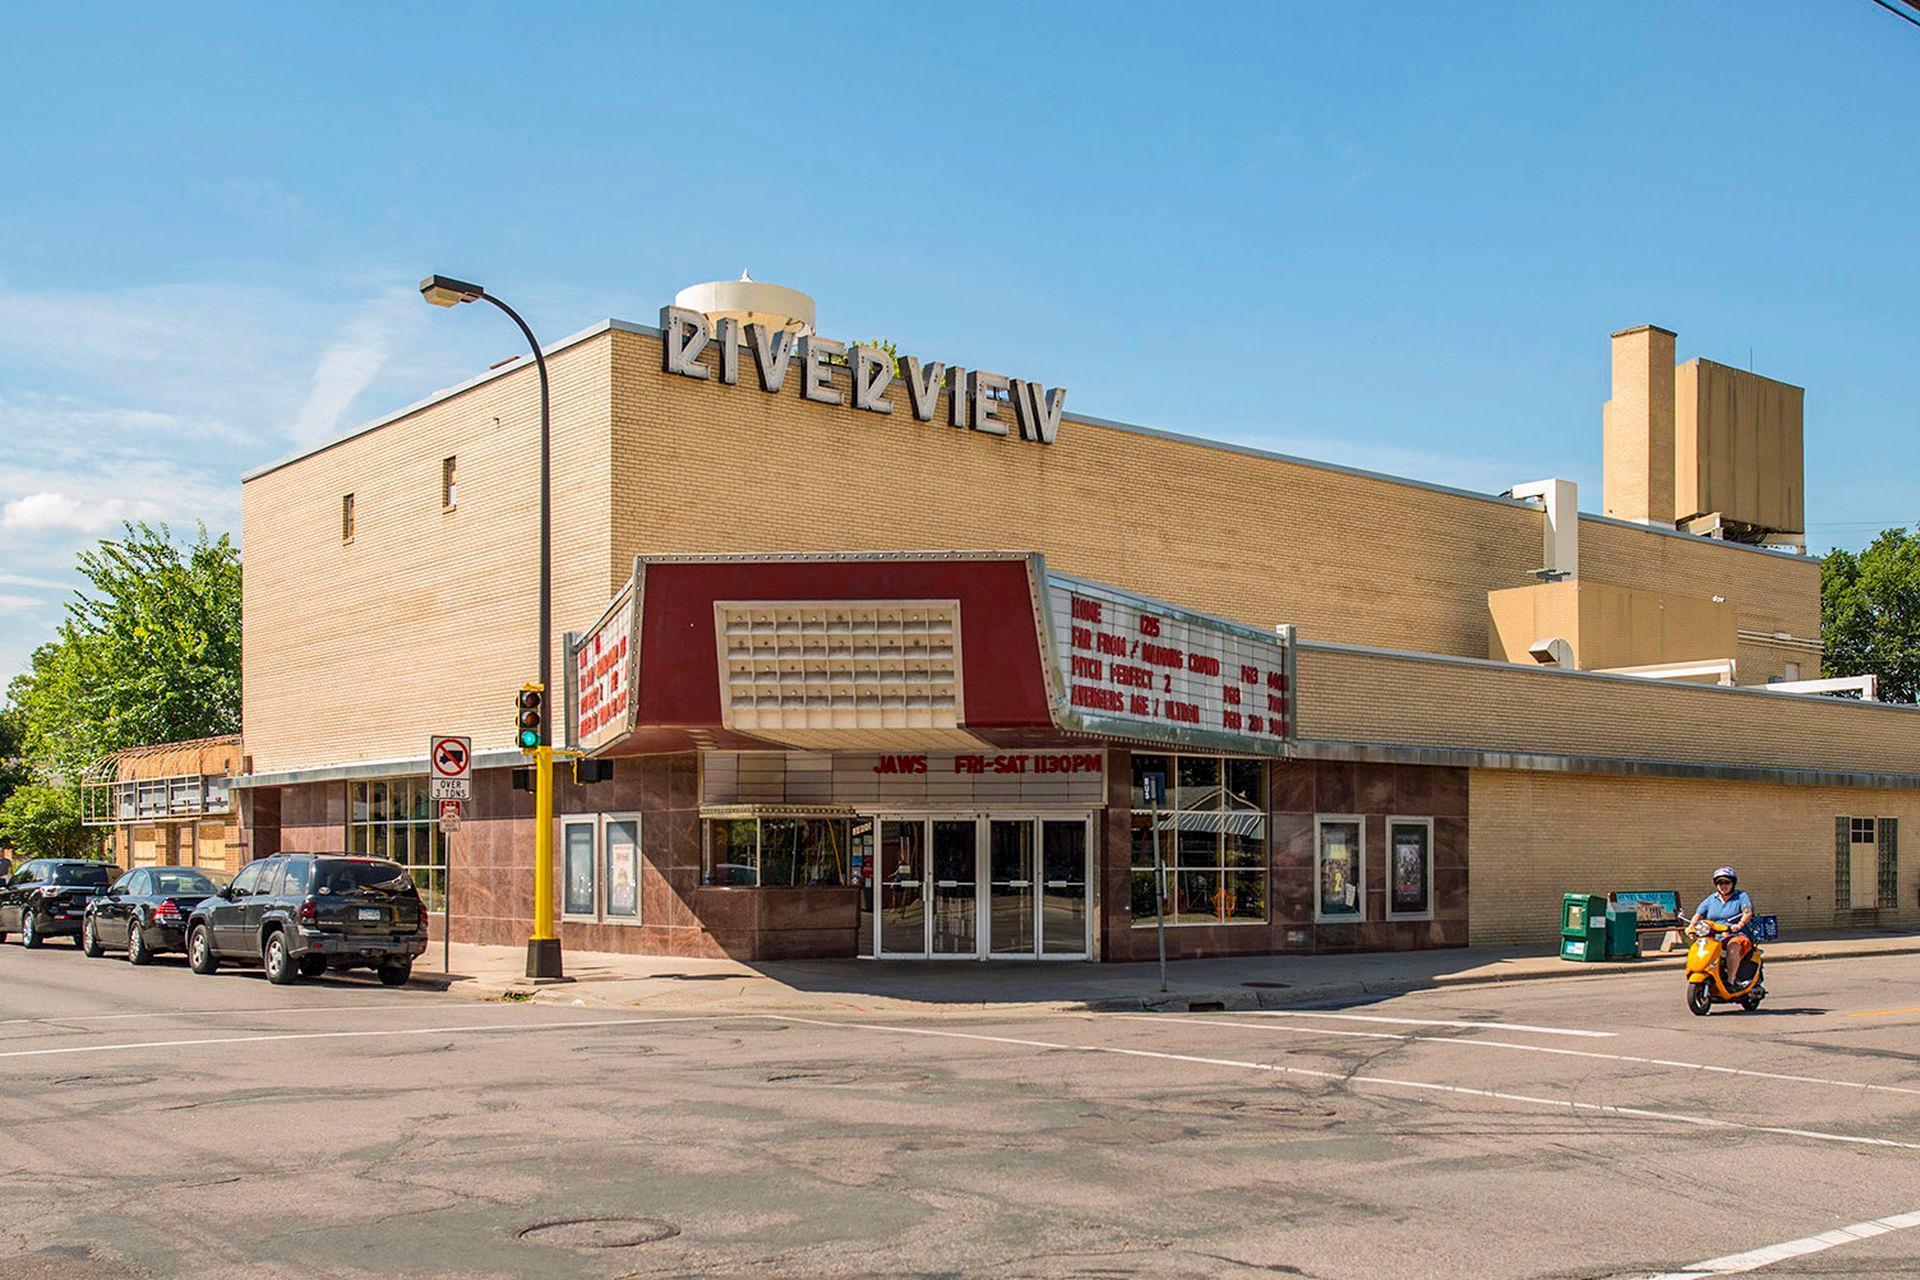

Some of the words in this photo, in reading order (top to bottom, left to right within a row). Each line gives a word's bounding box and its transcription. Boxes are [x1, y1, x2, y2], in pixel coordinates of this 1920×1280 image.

[660, 305, 1067, 444] RIVERVIEW
[1071, 597, 1102, 624] HOME
[1071, 626, 1092, 650] FAR
[1097, 631, 1127, 658] FROM
[1071, 655, 1103, 681] PITCH
[1110, 662, 1153, 690] PERFECT
[1164, 674, 1171, 694] 2
[1071, 684, 1125, 712] AVENGERS
[1165, 700, 1200, 724] ULTRON
[873, 754, 928, 774] JAWS
[954, 754, 1029, 774] FRI-SAT
[1034, 754, 1103, 774] 1130PM
[436, 788, 440, 797] 3
[445, 789, 465, 797] TONS
